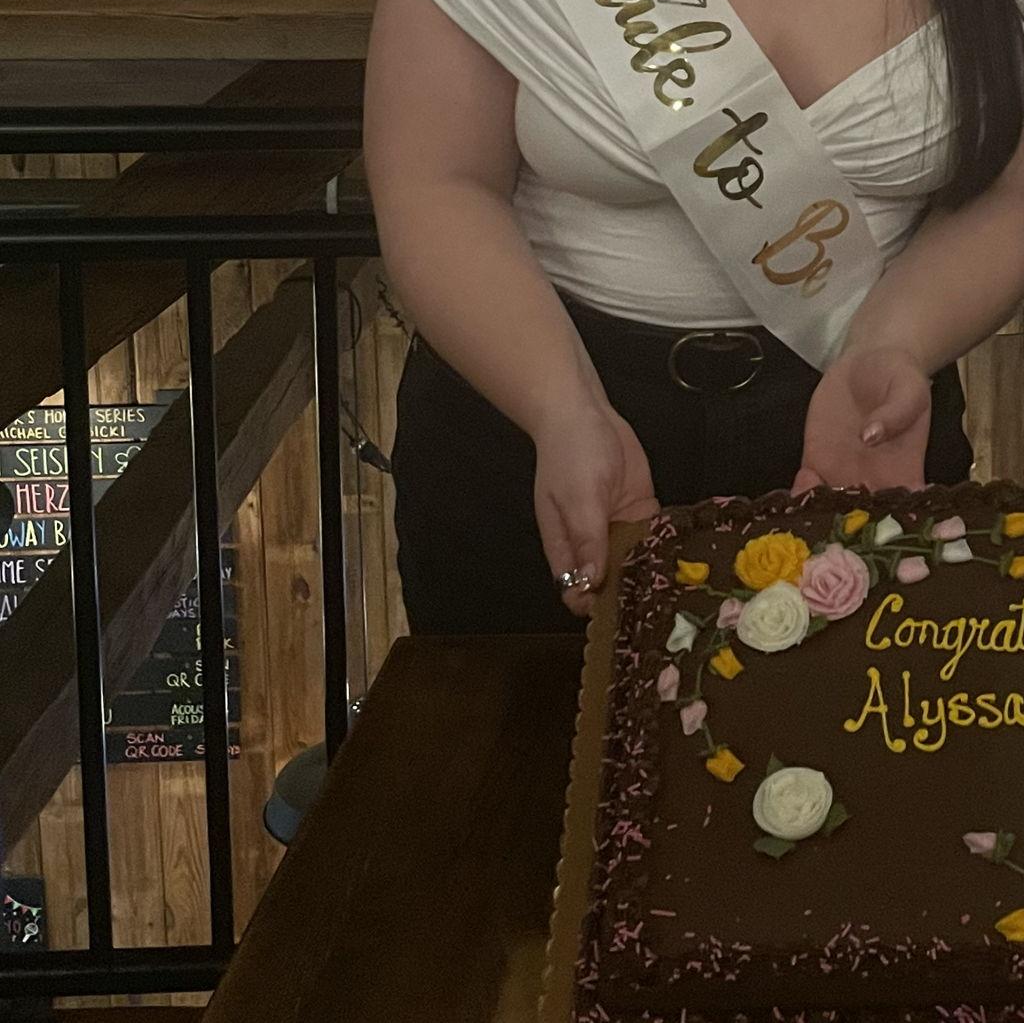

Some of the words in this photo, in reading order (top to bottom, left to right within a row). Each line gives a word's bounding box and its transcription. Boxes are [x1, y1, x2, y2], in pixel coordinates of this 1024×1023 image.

[693, 107, 769, 209] to
[751, 198, 850, 298] Be
[95, 408, 146, 424] SERIES
[166, 671, 191, 688] QR
[126, 733, 165, 744] SCAN
[124, 746, 148, 758] QR
[150, 744, 184, 758] CODE
